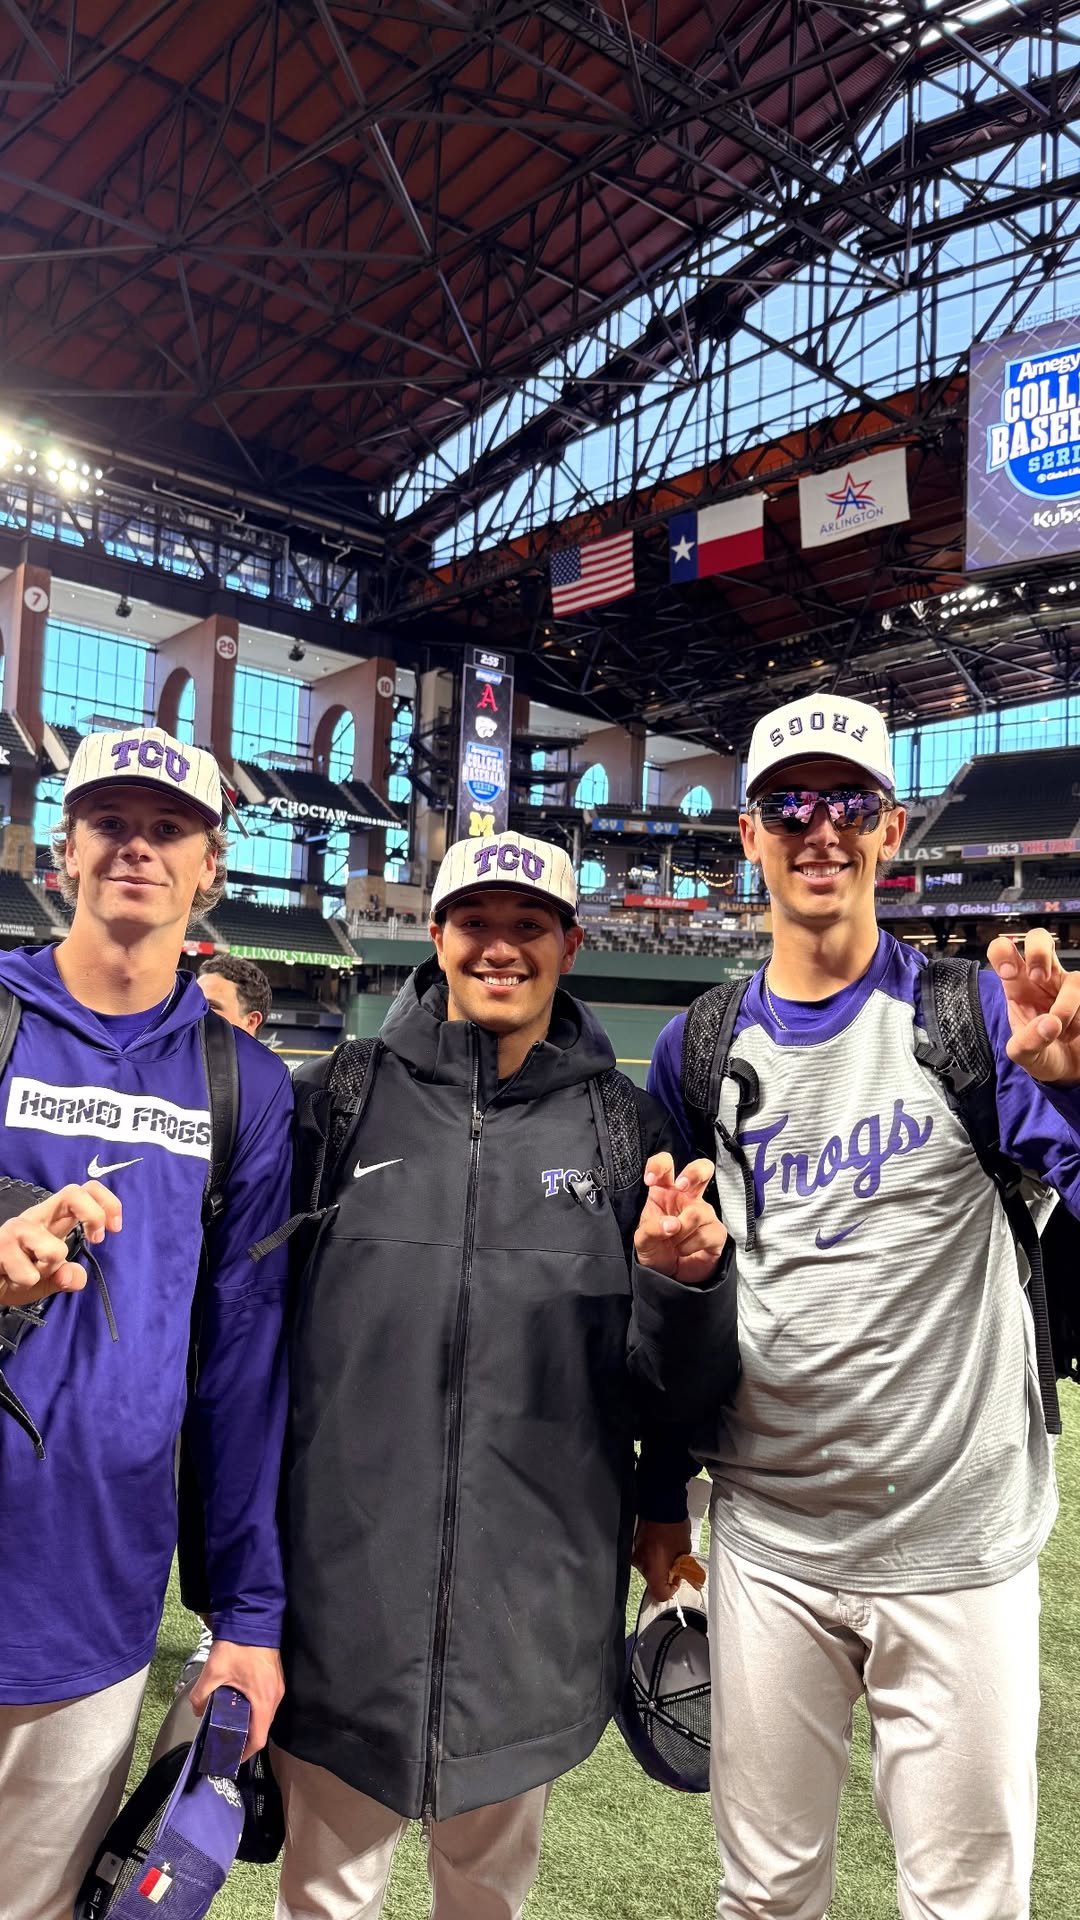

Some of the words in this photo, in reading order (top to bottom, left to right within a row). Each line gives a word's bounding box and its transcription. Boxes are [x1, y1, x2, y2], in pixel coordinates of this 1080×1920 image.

[1017, 352, 1080, 382] Amegy
[1004, 372, 1080, 423] COLL
[820, 507, 884, 534] ARLINGTON
[32, 591, 41, 606] 7
[219, 639, 235, 656] 29
[380, 680, 390, 694] 10
[476, 683, 498, 713] A
[769, 711, 869, 748] FROGS
[111, 738, 190, 782] TCU
[277, 797, 348, 822] CHOCTAW
[474, 844, 545, 880] TCU
[894, 846, 944, 862] LLAS
[986, 843, 1019, 856] 105.3
[960, 904, 990, 914] Globe
[991, 902, 1011, 913] Life
[243, 945, 289, 961] LUXOR
[290, 949, 352, 967] STAFFING
[19, 1090, 122, 1129] HORNED
[131, 1107, 211, 1147] FROGS
[737, 1098, 934, 1219] Frogs
